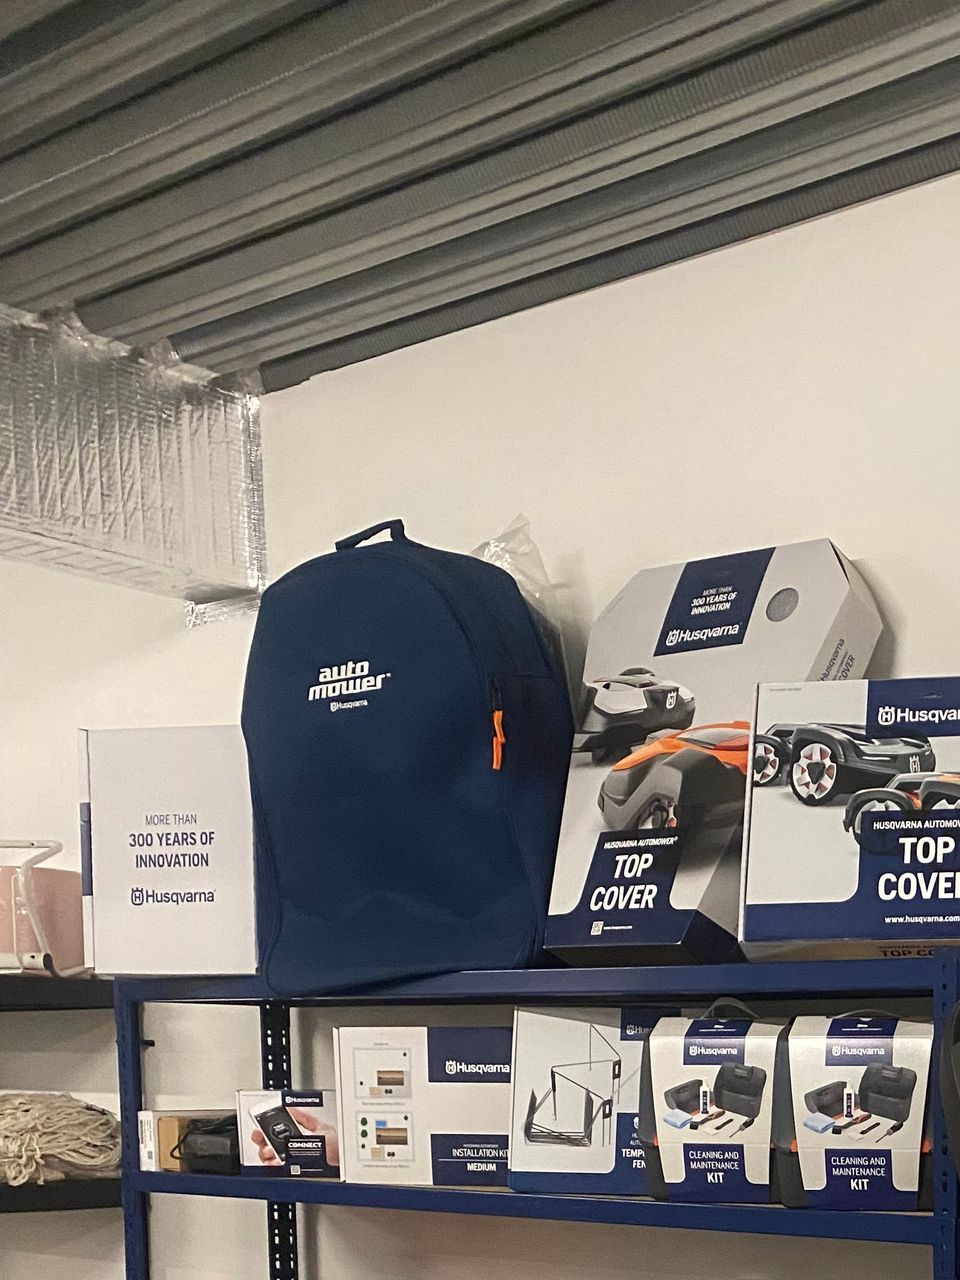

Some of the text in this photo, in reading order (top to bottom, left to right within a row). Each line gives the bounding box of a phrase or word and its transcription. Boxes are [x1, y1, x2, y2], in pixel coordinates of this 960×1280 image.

[691, 592, 738, 607] 300 YEARS OF
[691, 602, 732, 615] INNOVATION
[678, 624, 740, 642] Husqvarna
[319, 661, 370, 682] auto
[308, 674, 386, 701] mower
[338, 700, 369, 709] Husqvarna
[145, 813, 197, 826] MORE THAN
[873, 820, 923, 830] HUSQVARNA
[129, 831, 215, 847] 300 YEARS OF
[604, 840, 638, 849] HUSQVARNA
[899, 836, 955, 864] TOP
[135, 852, 209, 869] INNOVATION
[614, 853, 654, 879] TOP
[145, 889, 215, 905] Husqvarna
[590, 884, 658, 911] COVER
[884, 915, 960, 924] www.husqvarna.com
[698, 1046, 738, 1056] Husqvarna
[841, 1046, 885, 1056] Husqvarna
[457, 1062, 510, 1076] Husqvarna
[452, 1148, 498, 1158] INSTALLATION
[689, 1151, 739, 1159] CLEANING AND
[690, 1161, 739, 1170] MAINTENANCE
[831, 1156, 886, 1165] CLEANING AND
[467, 1163, 497, 1171] MEDIUM
[832, 1167, 886, 1176] MAINTENANCE
[707, 1172, 724, 1183] KIT
[850, 1179, 869, 1190] KIT
